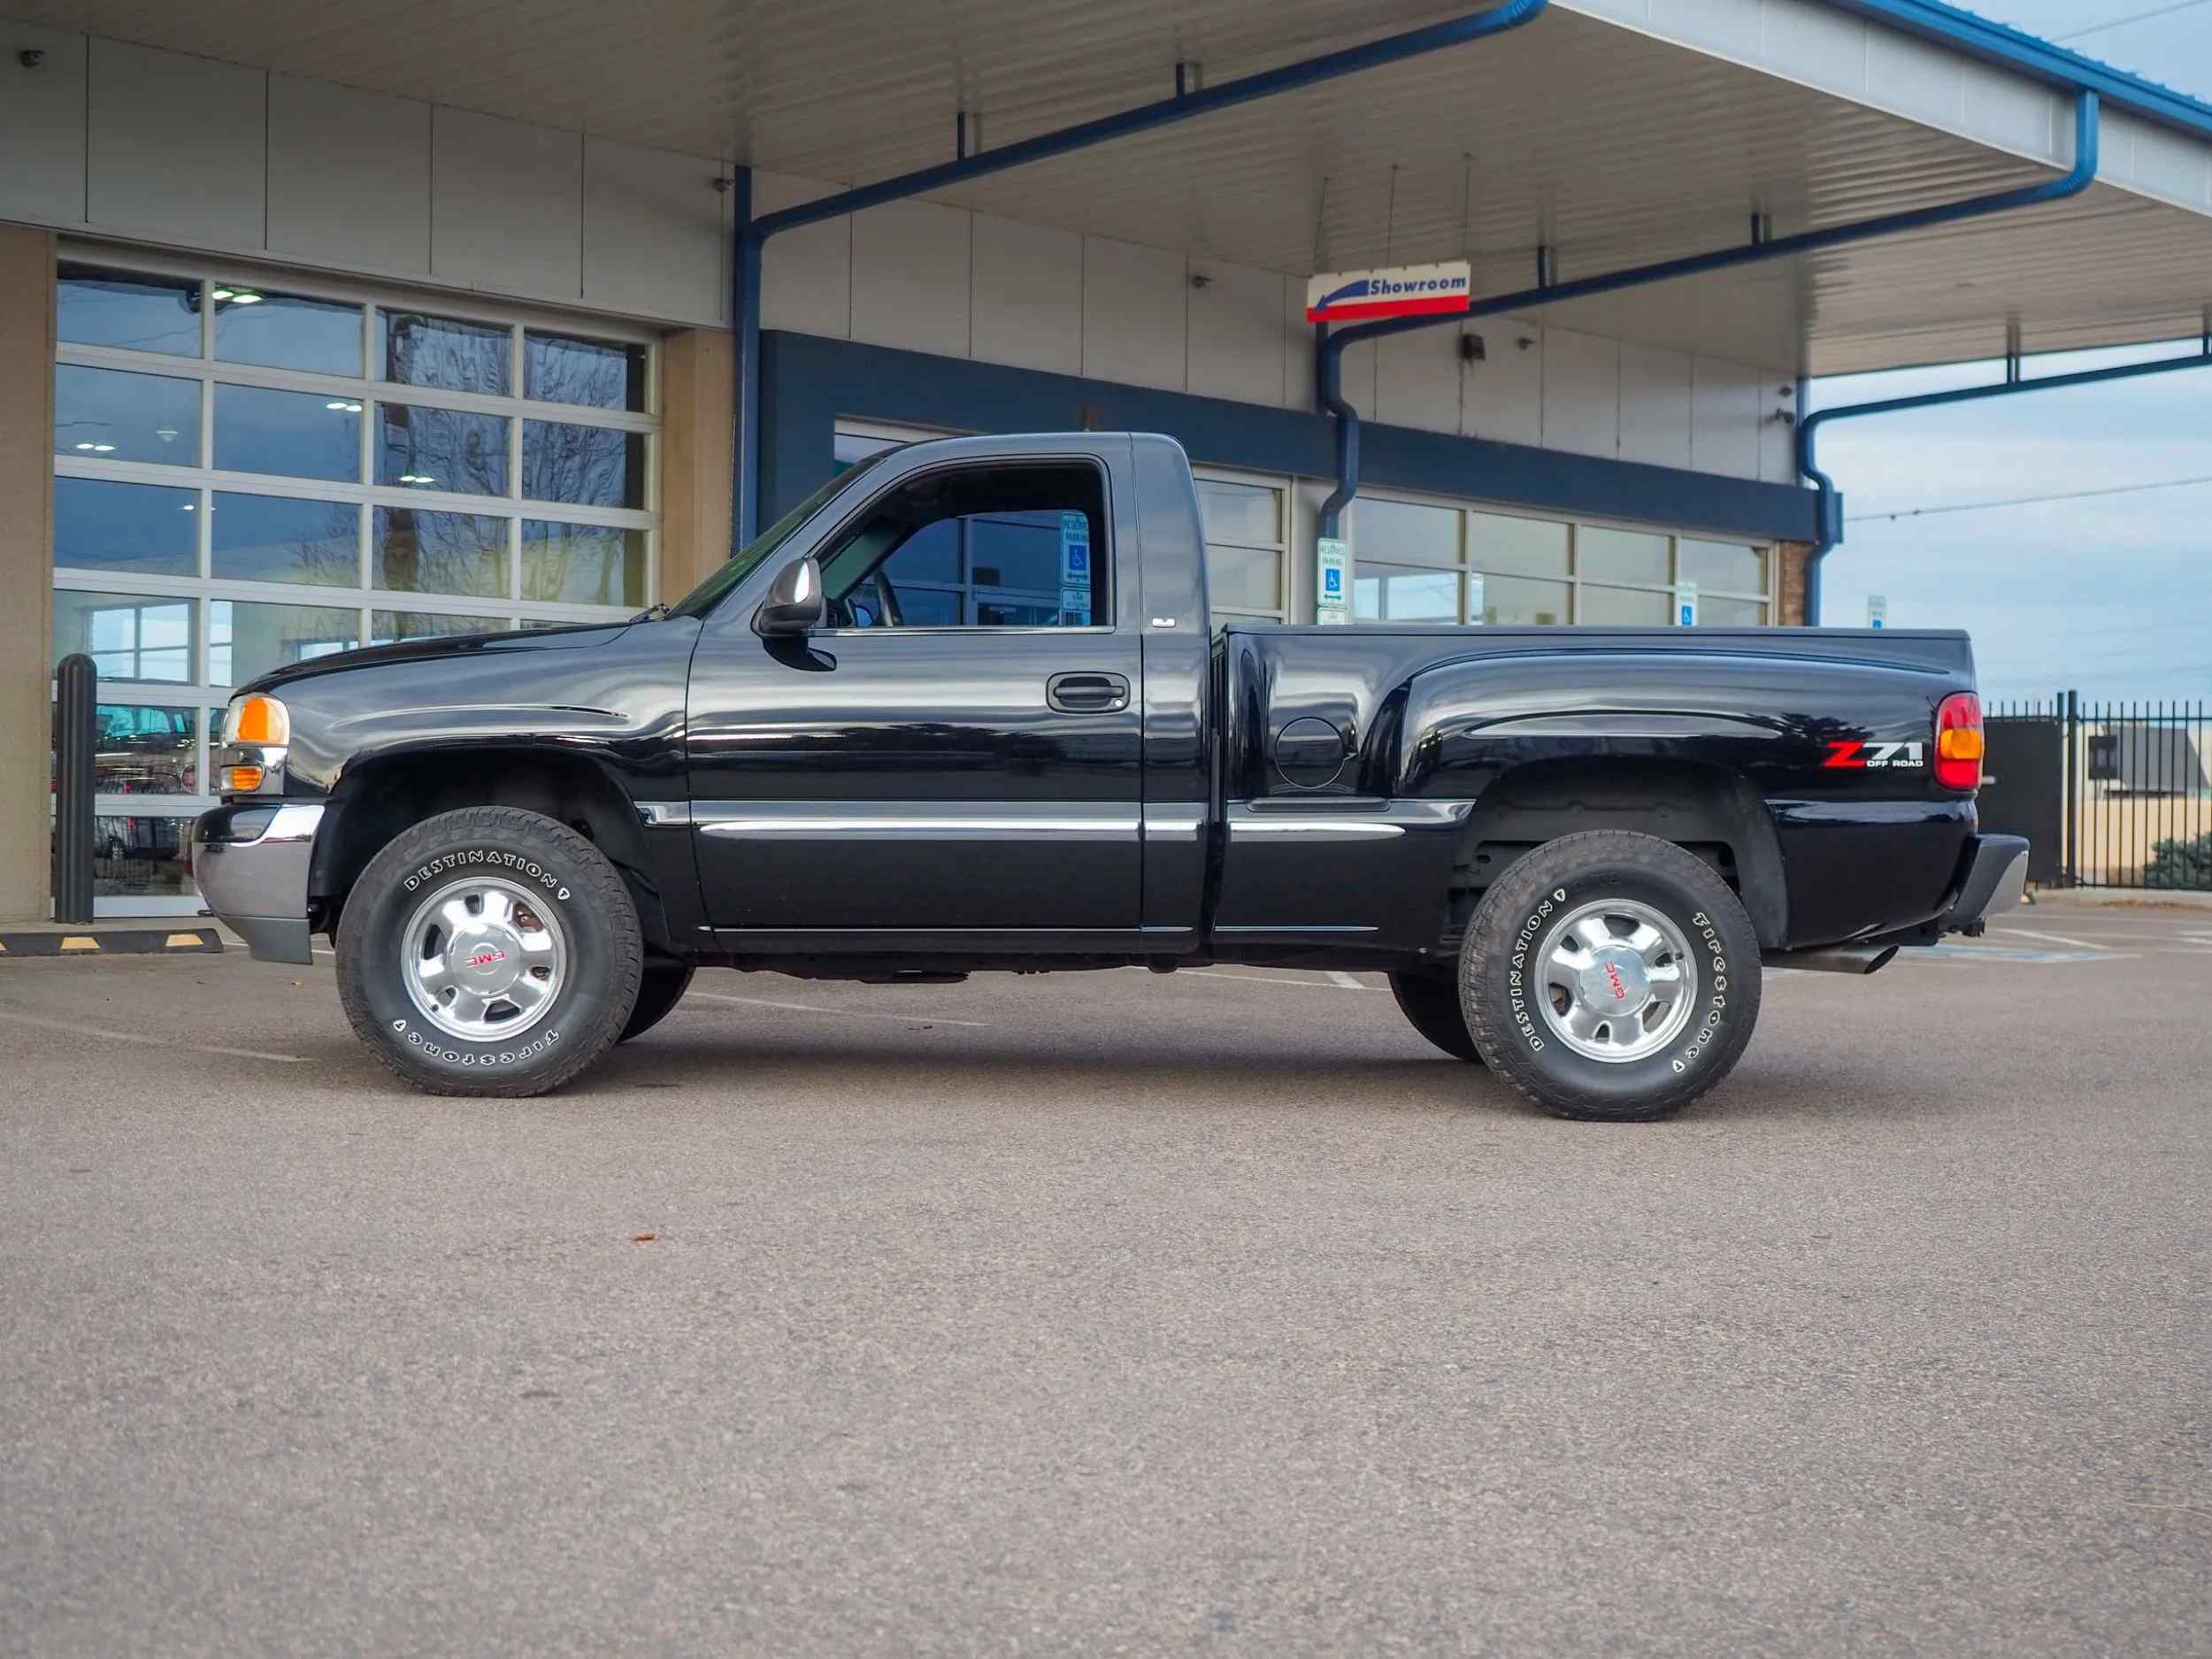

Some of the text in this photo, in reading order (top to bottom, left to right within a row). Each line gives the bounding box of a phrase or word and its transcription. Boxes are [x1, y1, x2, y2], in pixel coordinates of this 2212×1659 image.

[1370, 276, 1467, 296] Showroom
[1824, 741, 1924, 767] Z71
[403, 849, 557, 892] DESTINATION
[465, 949, 510, 969] GMC
[1509, 900, 1554, 1052] DESTINATION
[1604, 961, 1626, 1002] GMC
